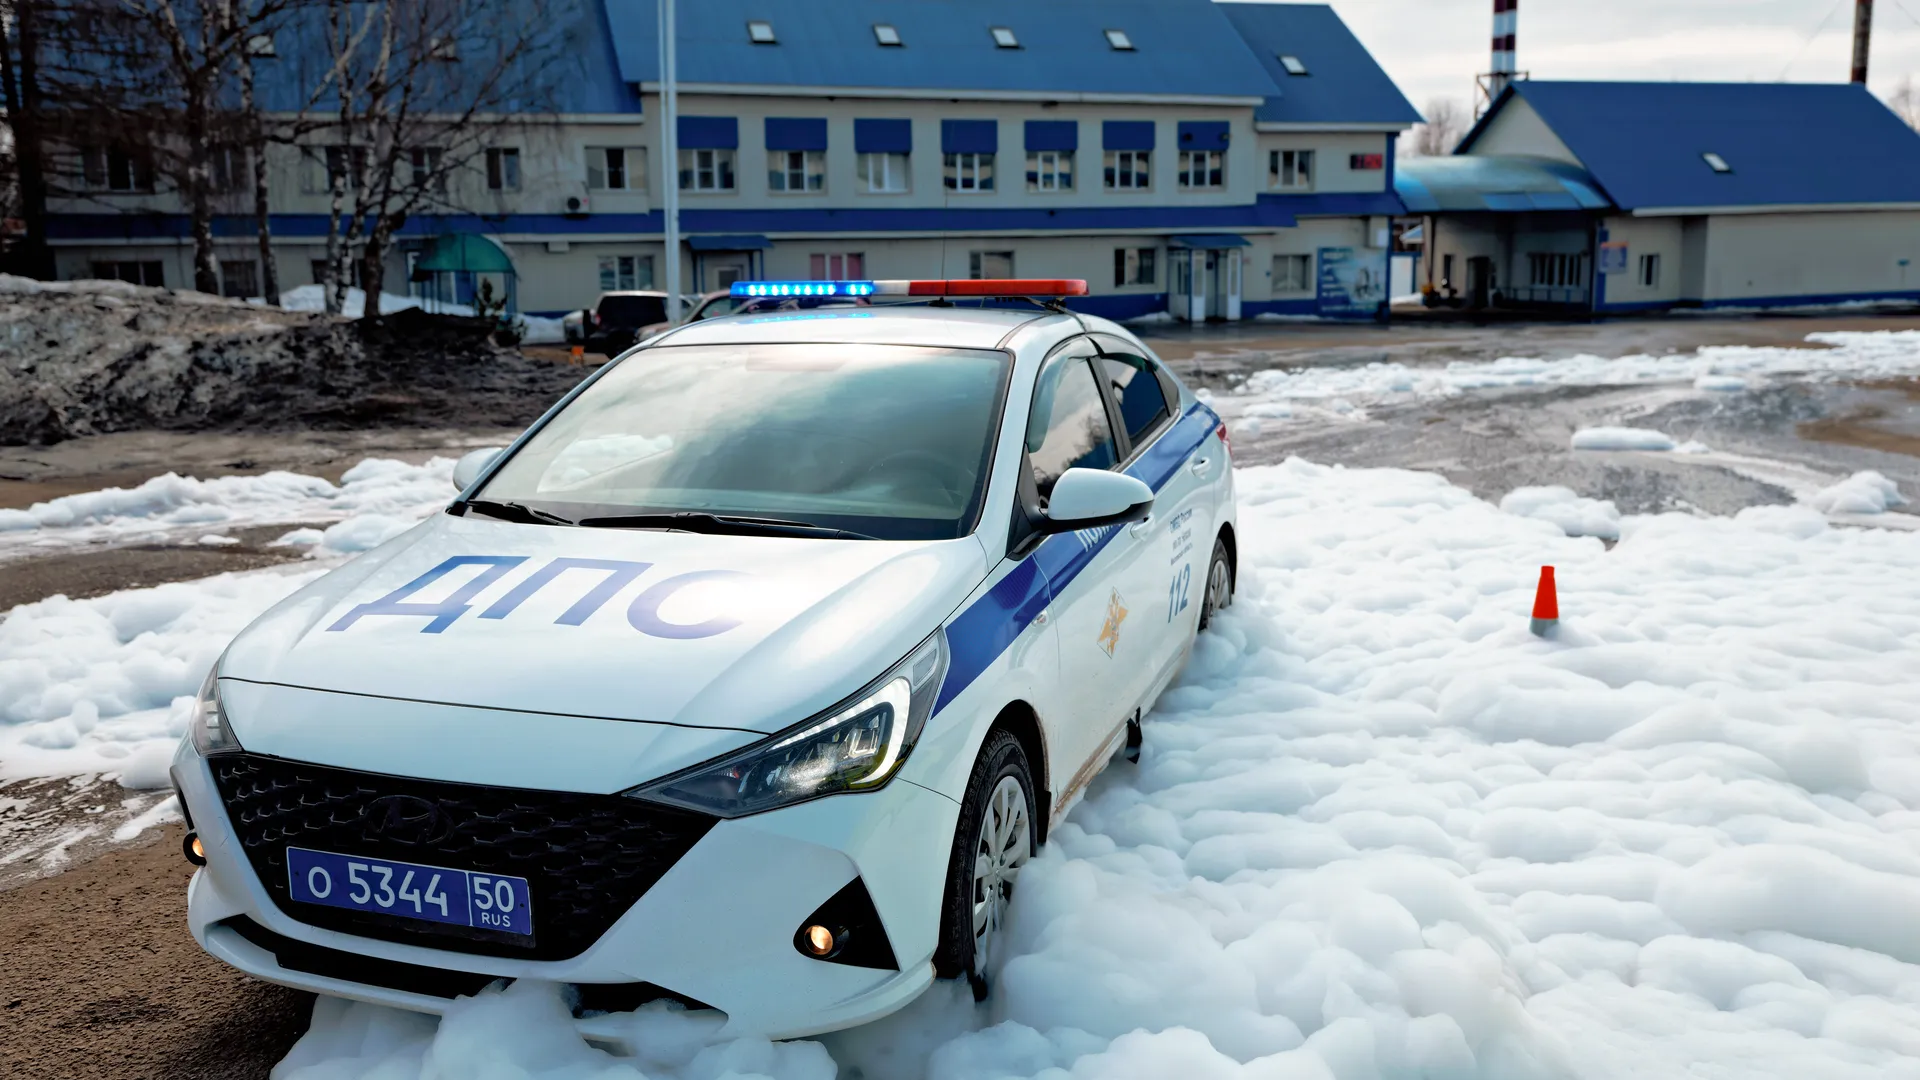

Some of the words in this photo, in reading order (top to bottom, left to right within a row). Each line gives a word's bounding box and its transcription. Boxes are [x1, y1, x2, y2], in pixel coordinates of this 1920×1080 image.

[325, 555, 756, 640] ДПС
[1168, 563, 1190, 623] 112
[347, 861, 449, 917] 5344
[472, 876, 515, 913] 50
[481, 912, 511, 927] RUS
